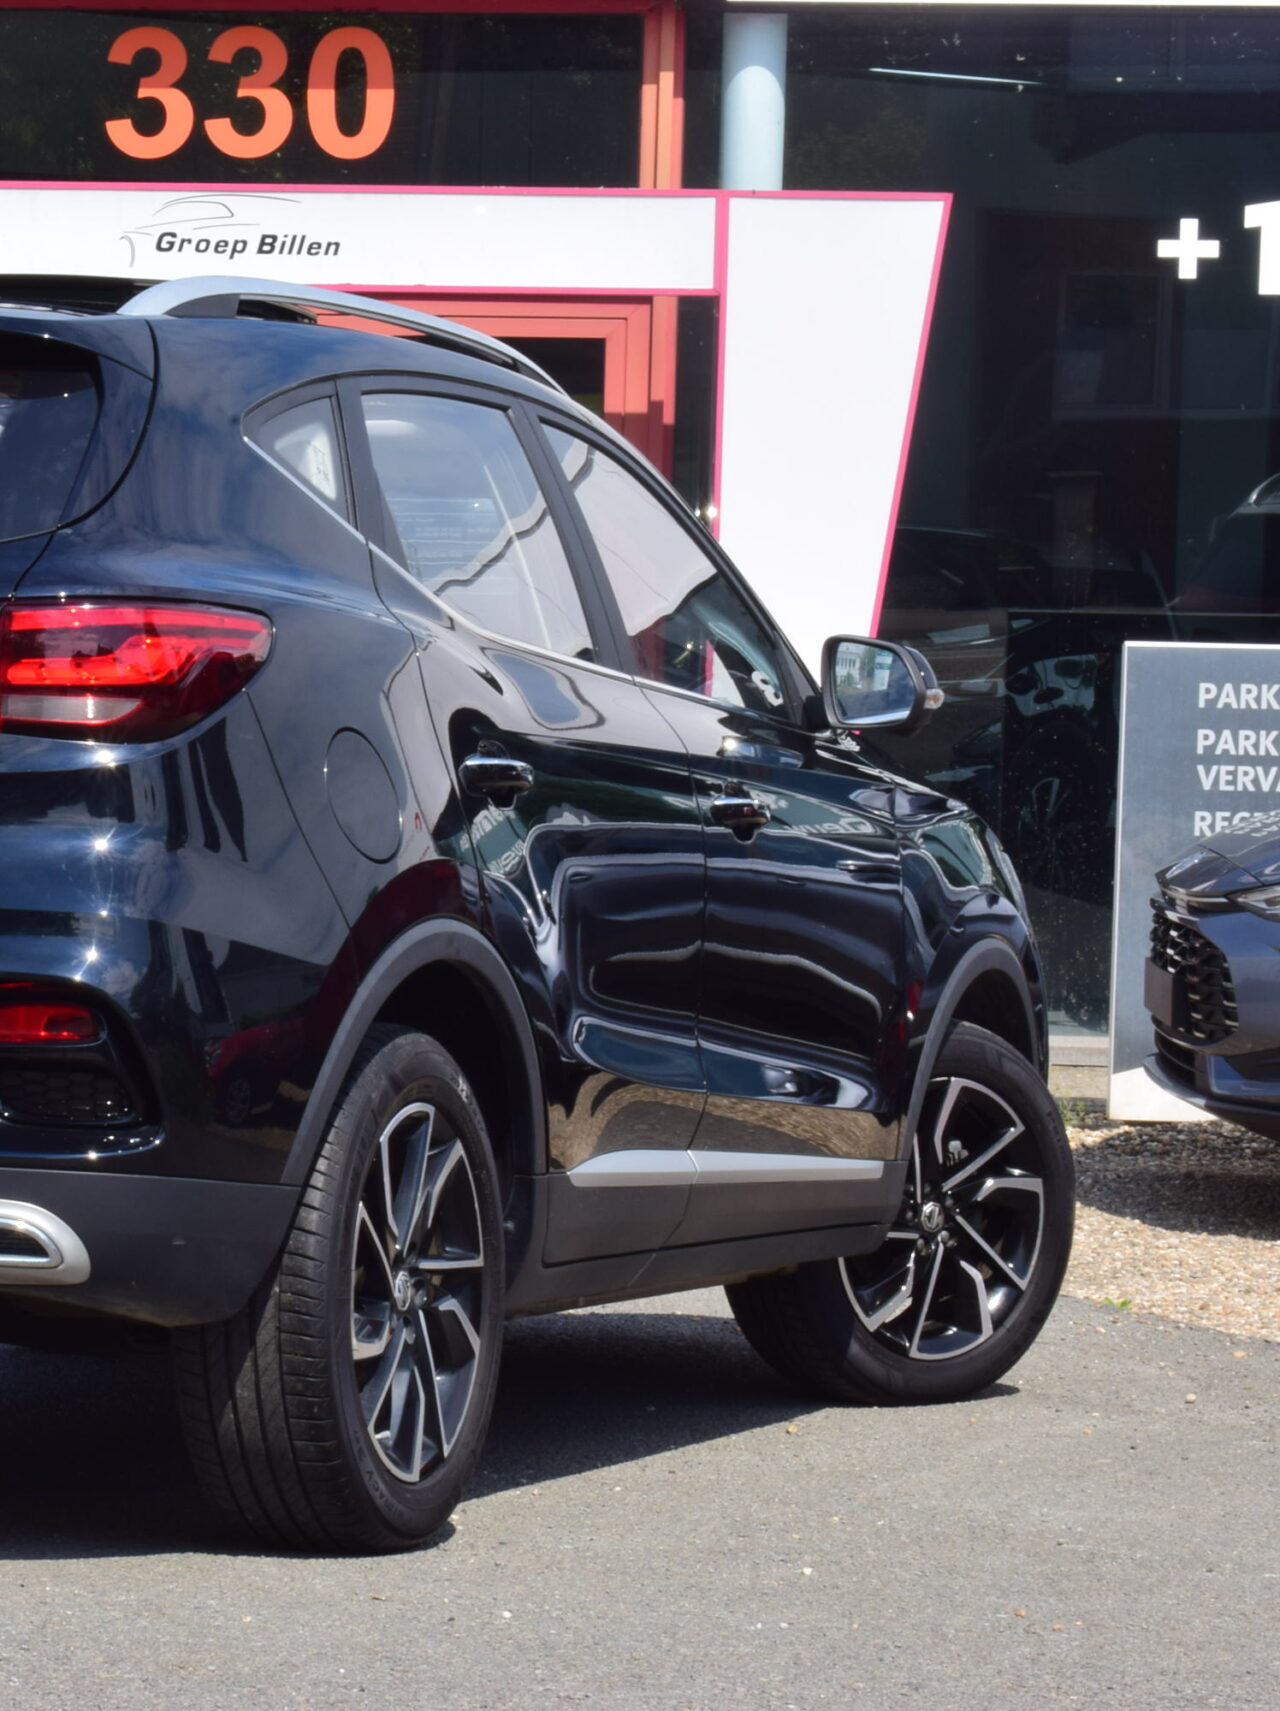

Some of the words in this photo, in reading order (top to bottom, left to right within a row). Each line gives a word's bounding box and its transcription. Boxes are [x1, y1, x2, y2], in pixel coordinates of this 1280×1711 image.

[104, 25, 395, 160] 330
[155, 231, 249, 260] Groep
[256, 233, 341, 257] Billen
[1197, 682, 1280, 710] PARK
[1196, 728, 1280, 756] PARK
[1196, 764, 1280, 793] VERV
